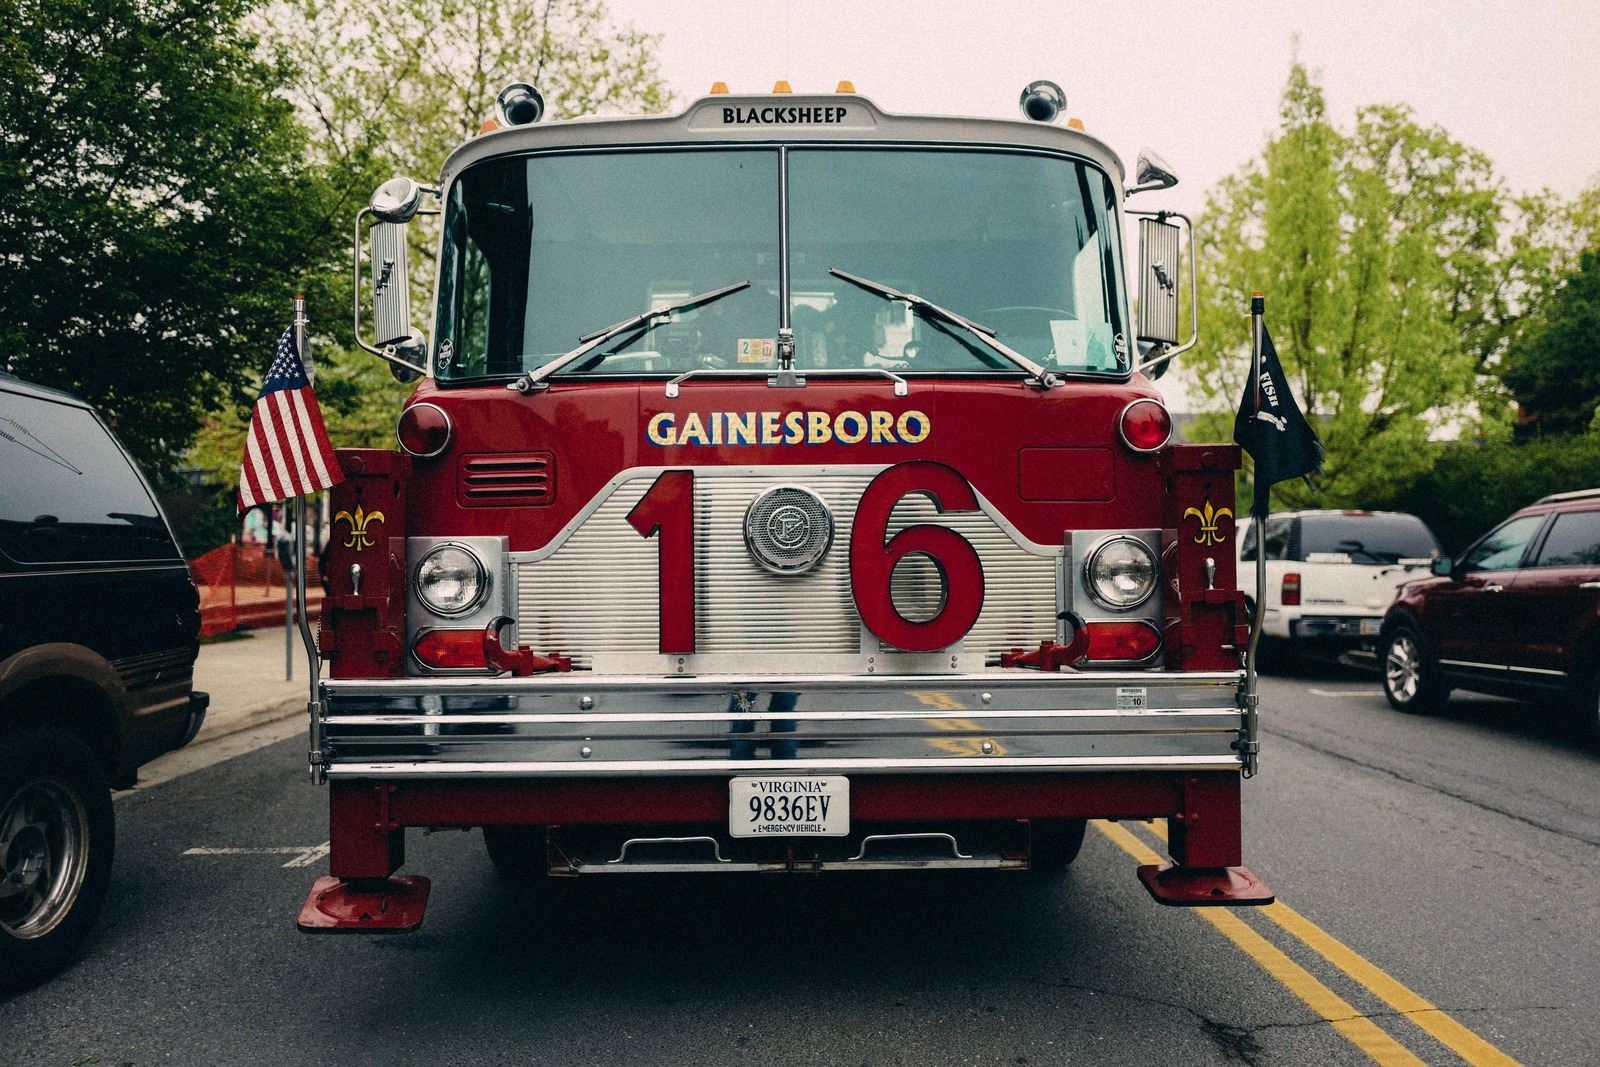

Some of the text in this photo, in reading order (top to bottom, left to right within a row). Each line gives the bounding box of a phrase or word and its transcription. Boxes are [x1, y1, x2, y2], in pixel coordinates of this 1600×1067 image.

[722, 107, 847, 124] BLACKSHEEP
[743, 341, 749, 355] 2
[1260, 371, 1279, 407] FISH
[646, 410, 931, 447] GAINESBORO
[759, 781, 822, 793] VIRGINIA
[749, 795, 831, 822] 9836EV
[758, 824, 821, 833] EMERGENCY VEHICLE
